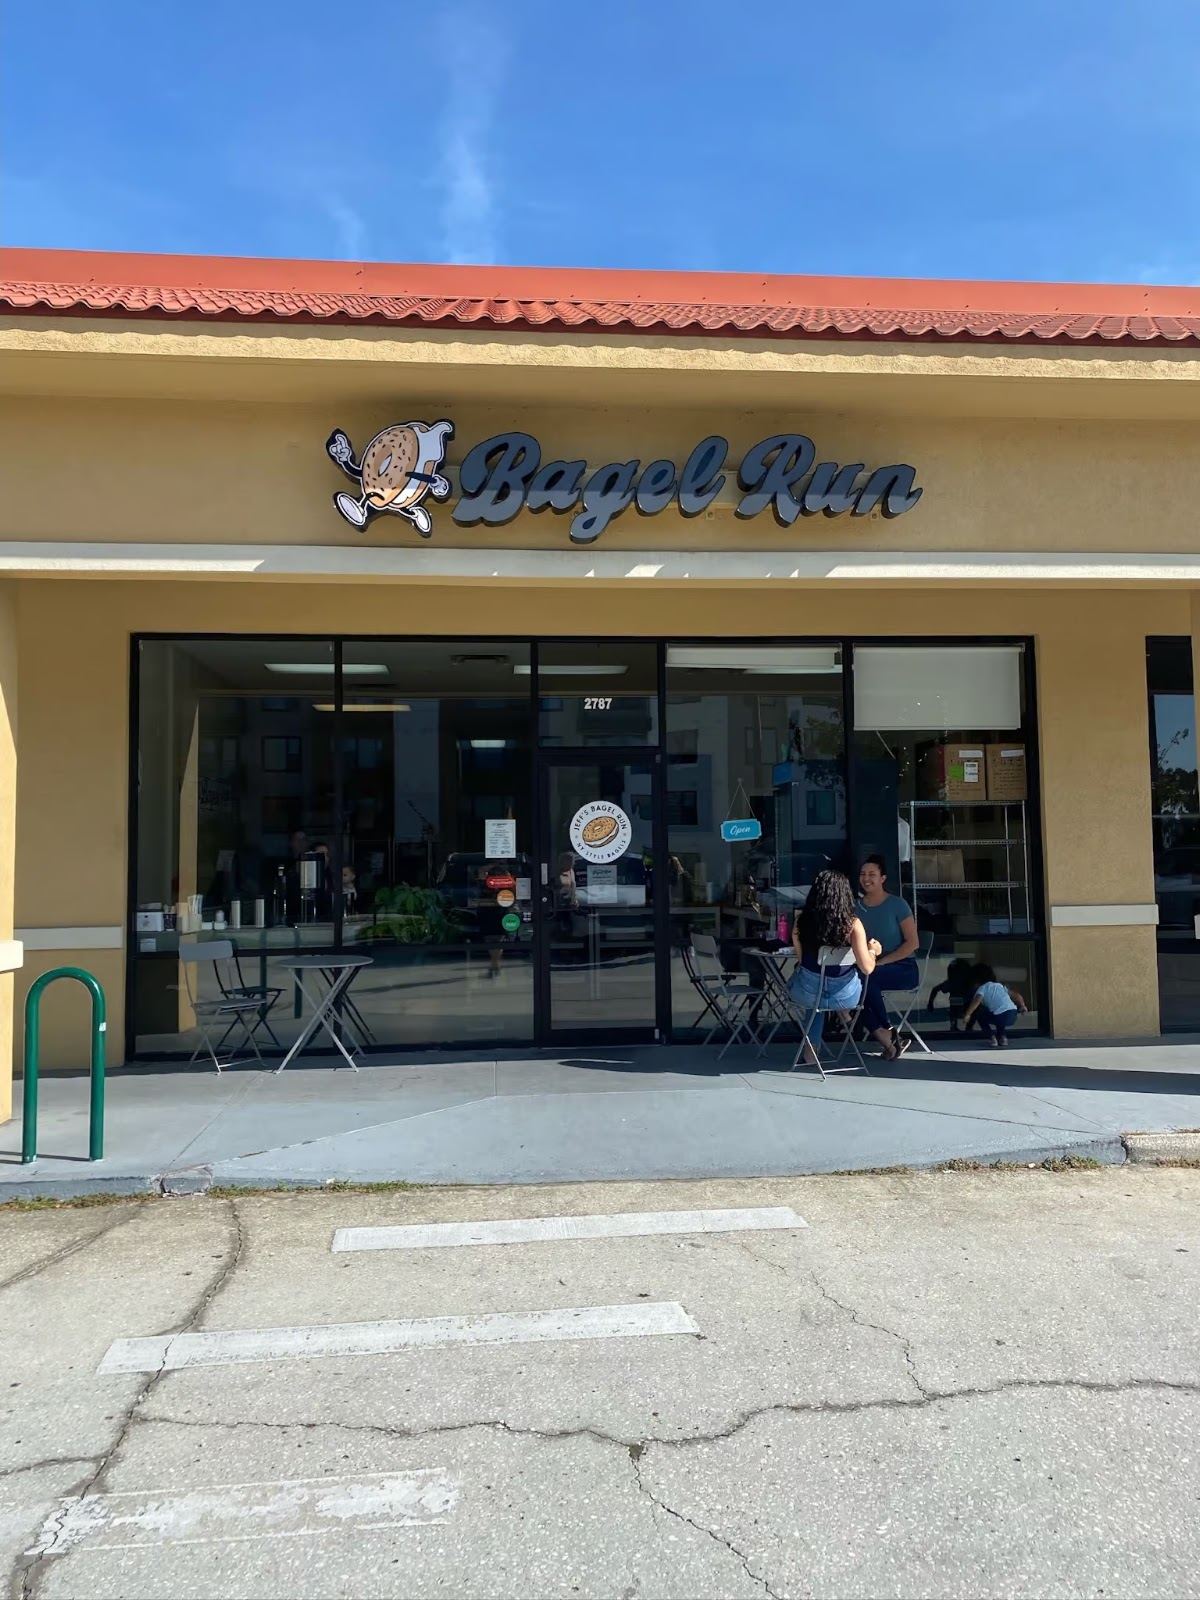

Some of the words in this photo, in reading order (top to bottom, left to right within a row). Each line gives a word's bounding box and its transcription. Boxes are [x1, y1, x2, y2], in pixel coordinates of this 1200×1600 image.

[452, 432, 730, 543] Bagel
[736, 434, 923, 527] Run
[584, 697, 612, 710] 2787
[574, 809, 589, 831] JEFF'S
[590, 804, 616, 815] BAGEL
[616, 813, 628, 830] RUN
[730, 825, 751, 836] Open
